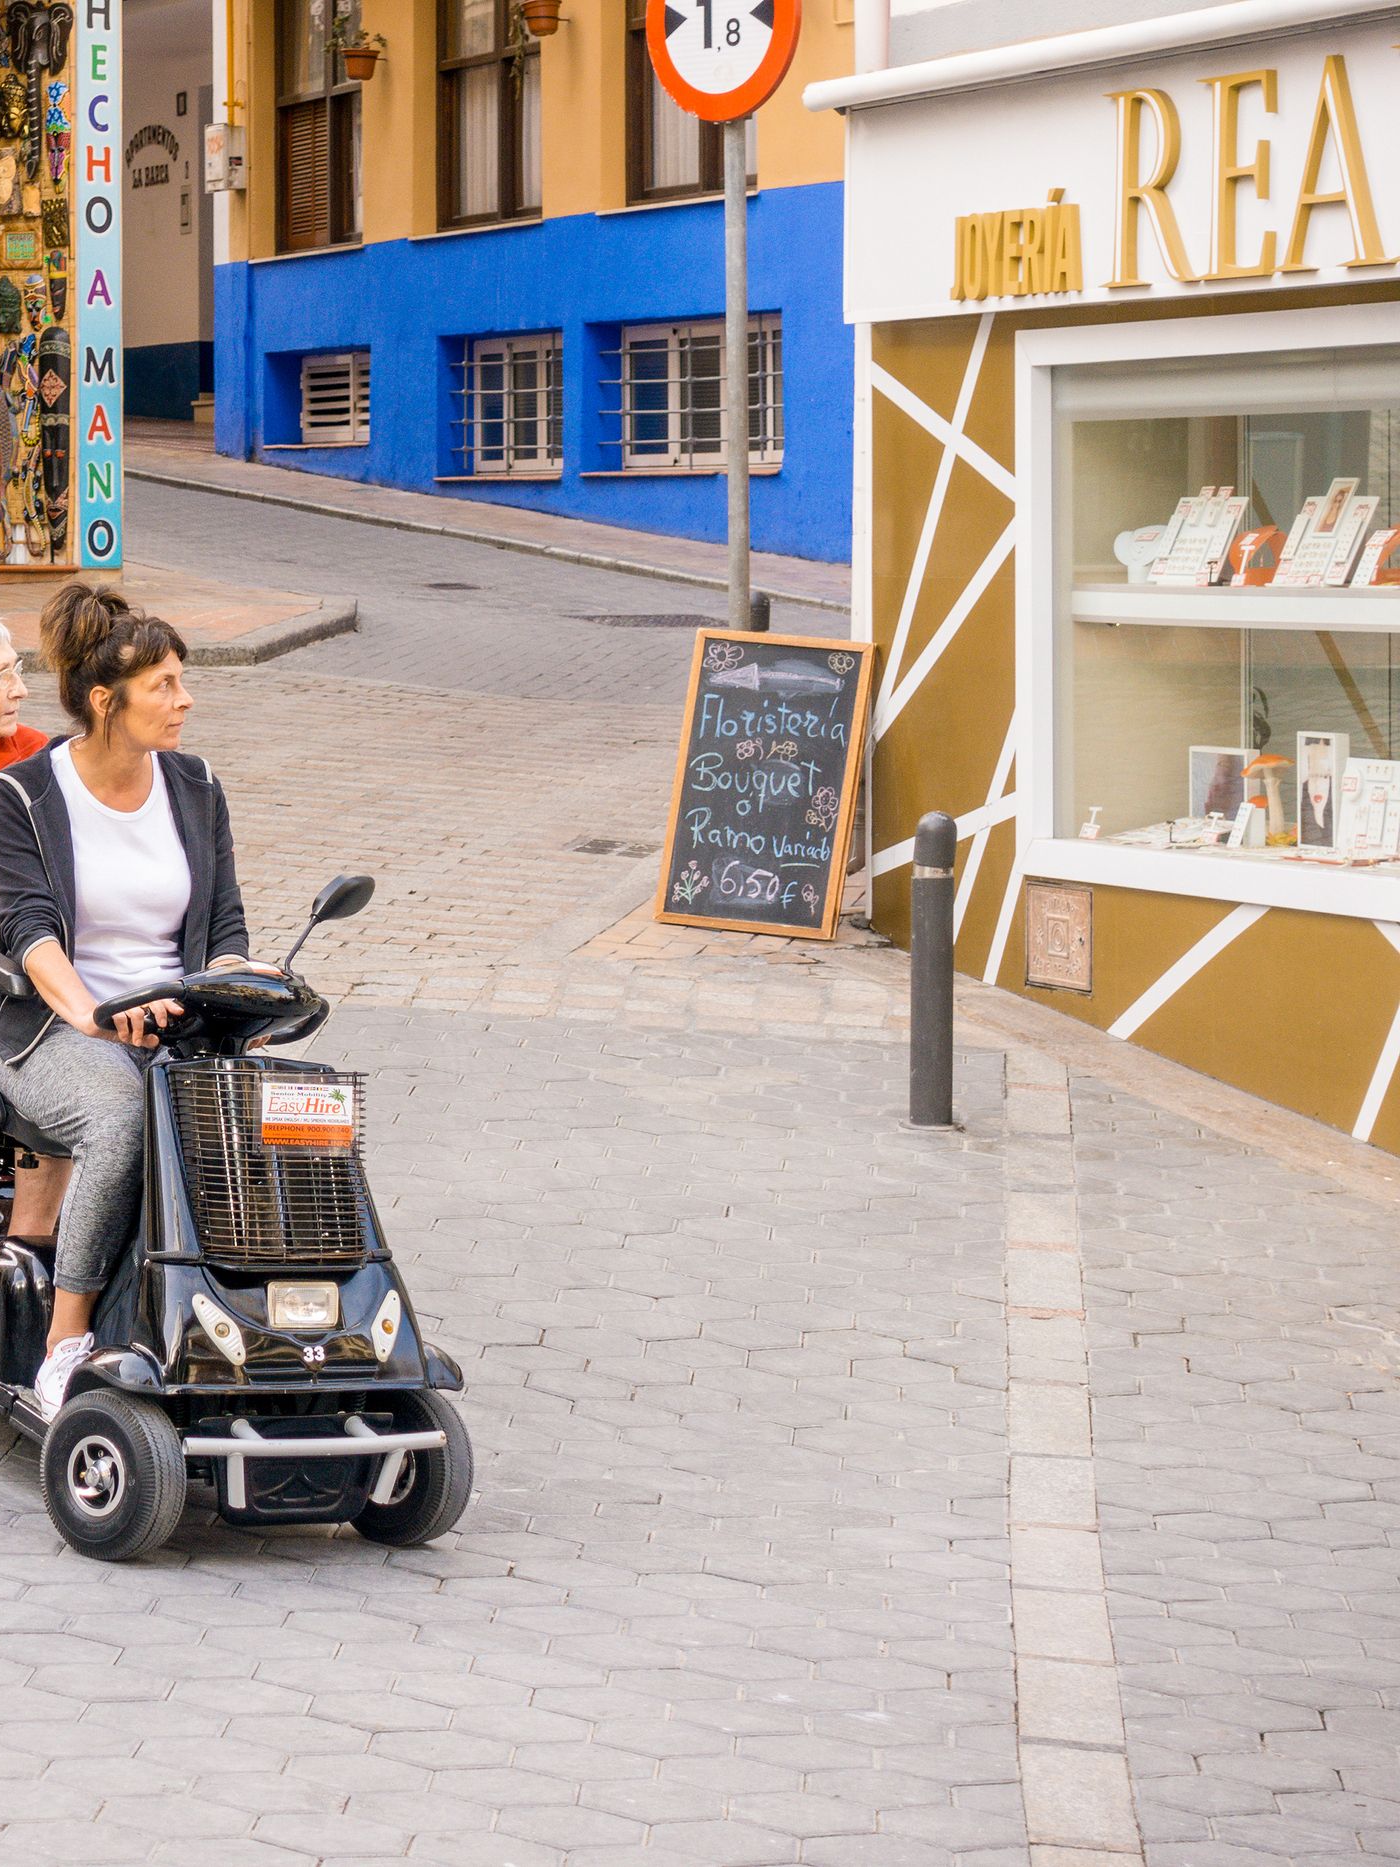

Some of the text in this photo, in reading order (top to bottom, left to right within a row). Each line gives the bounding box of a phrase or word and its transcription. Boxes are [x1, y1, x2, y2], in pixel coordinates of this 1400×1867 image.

[1100, 44, 1400, 289] REA
[949, 188, 1083, 302] JOYERÍA
[84, 0, 115, 557] HECHO A MANO
[698, 693, 846, 748] Floristería
[689, 752, 822, 813] Bouquet
[684, 806, 831, 861] Ramo Variado
[263, 1138, 351, 1148] WWW.EASYHIRE.INFO
[303, 1345, 325, 1362] 33
